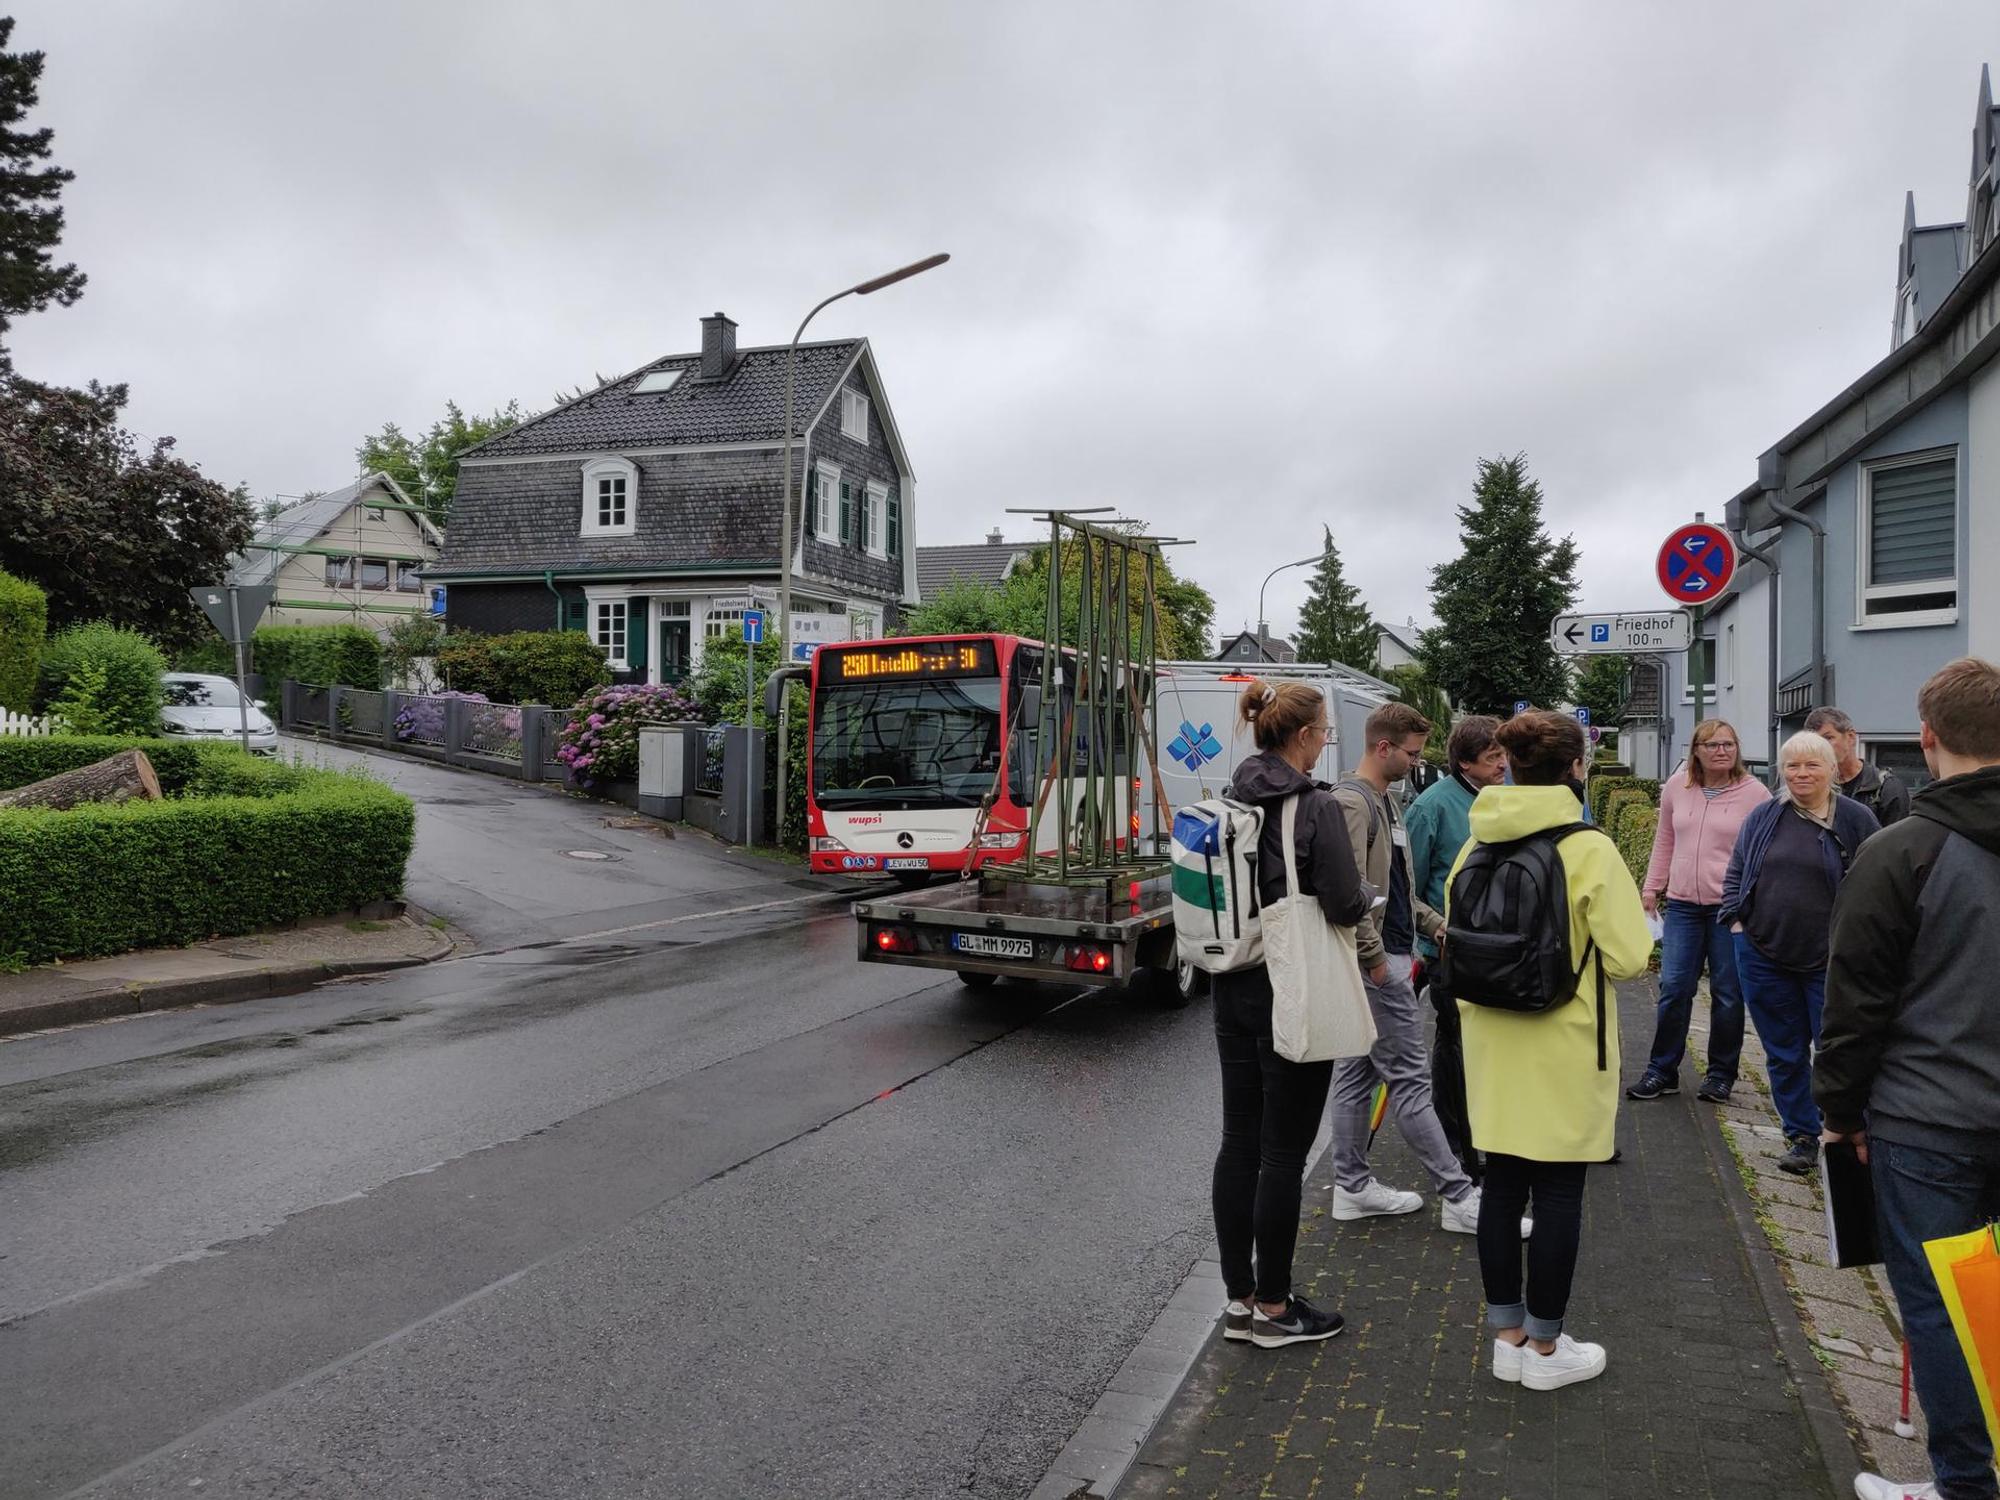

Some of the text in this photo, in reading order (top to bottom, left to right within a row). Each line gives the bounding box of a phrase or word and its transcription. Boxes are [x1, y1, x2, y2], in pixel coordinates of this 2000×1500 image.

[715, 599, 747, 609] Friedhofsweg
[1615, 617, 1674, 631] Friedhof
[1594, 626, 1606, 641] P
[1627, 634, 1662, 646] 100 m
[848, 813, 882, 826] wupsi
[958, 935, 1031, 955] GL MM 9975
